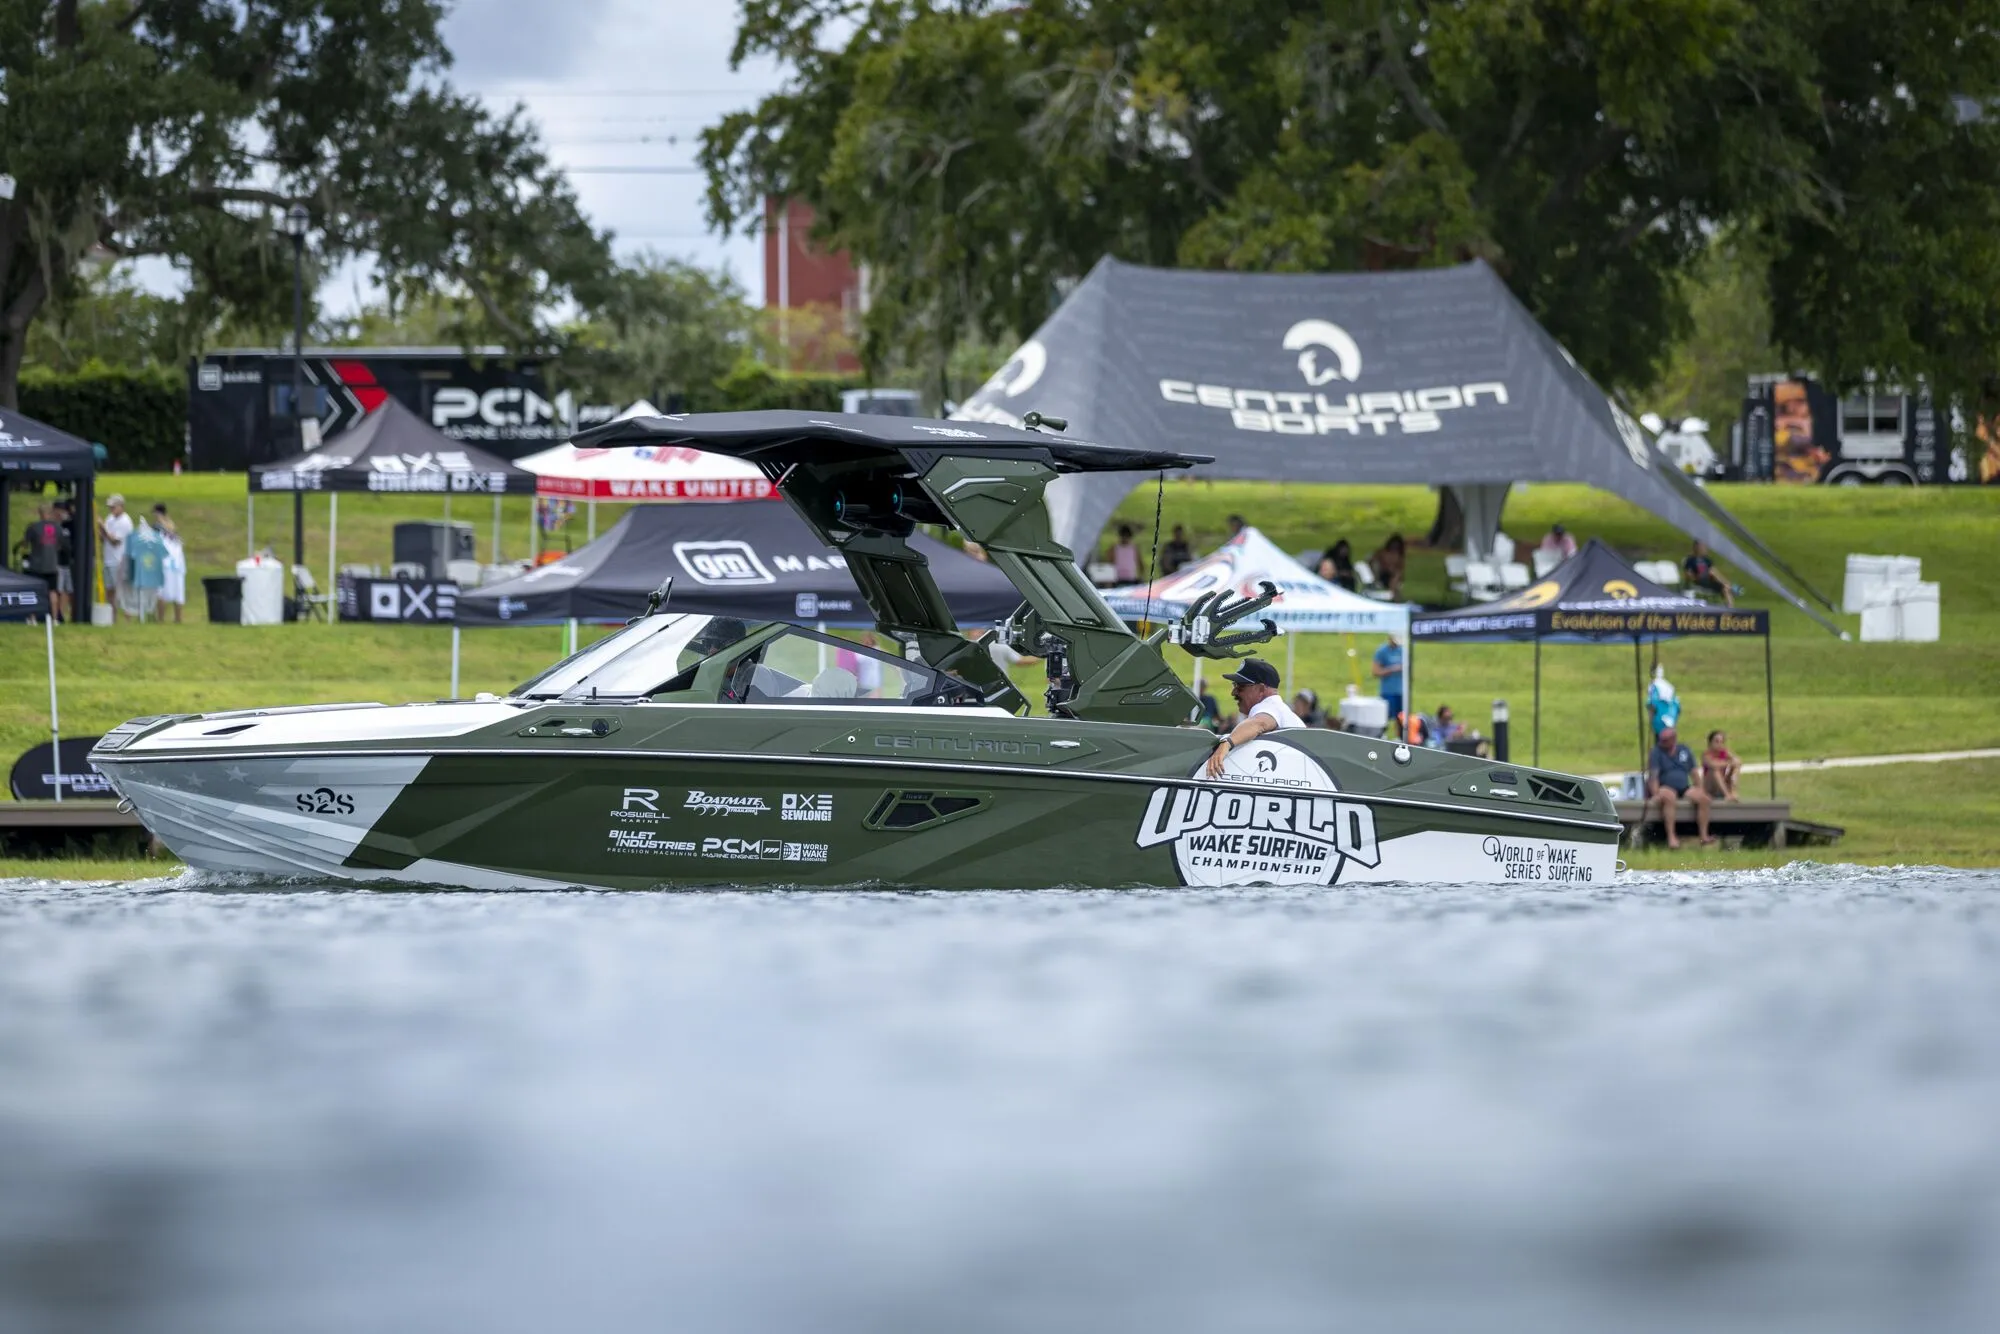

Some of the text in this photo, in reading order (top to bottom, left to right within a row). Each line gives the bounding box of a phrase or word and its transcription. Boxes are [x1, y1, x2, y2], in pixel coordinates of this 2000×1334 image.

[432, 387, 573, 427] PCM
[1159, 379, 1509, 415] CENTURION
[1231, 408, 1441, 435] BOATS
[610, 480, 677, 497] WAKE
[684, 479, 772, 497] UNITED
[772, 554, 847, 572] MAR
[370, 583, 460, 619] OXE
[1551, 611, 1757, 632] Evolution of the Wake Boat
[874, 734, 1042, 755] CENTURION
[1221, 773, 1312, 787] CENTURION
[623, 788, 659, 811] R
[610, 810, 671, 819] ROSWELL
[609, 829, 656, 841] BILLET
[1134, 786, 1381, 870] WORLD
[616, 838, 696, 851] INDUSTRIES
[702, 837, 761, 854] PCM
[801, 850, 828, 858] WAKE
[802, 843, 829, 851] WORLD
[1189, 834, 1328, 861] WAKE SURFING
[1483, 836, 1533, 862] WORLD
[1543, 843, 1577, 864] WAKE
[1191, 856, 1322, 875] CHAMPIONSHIP
